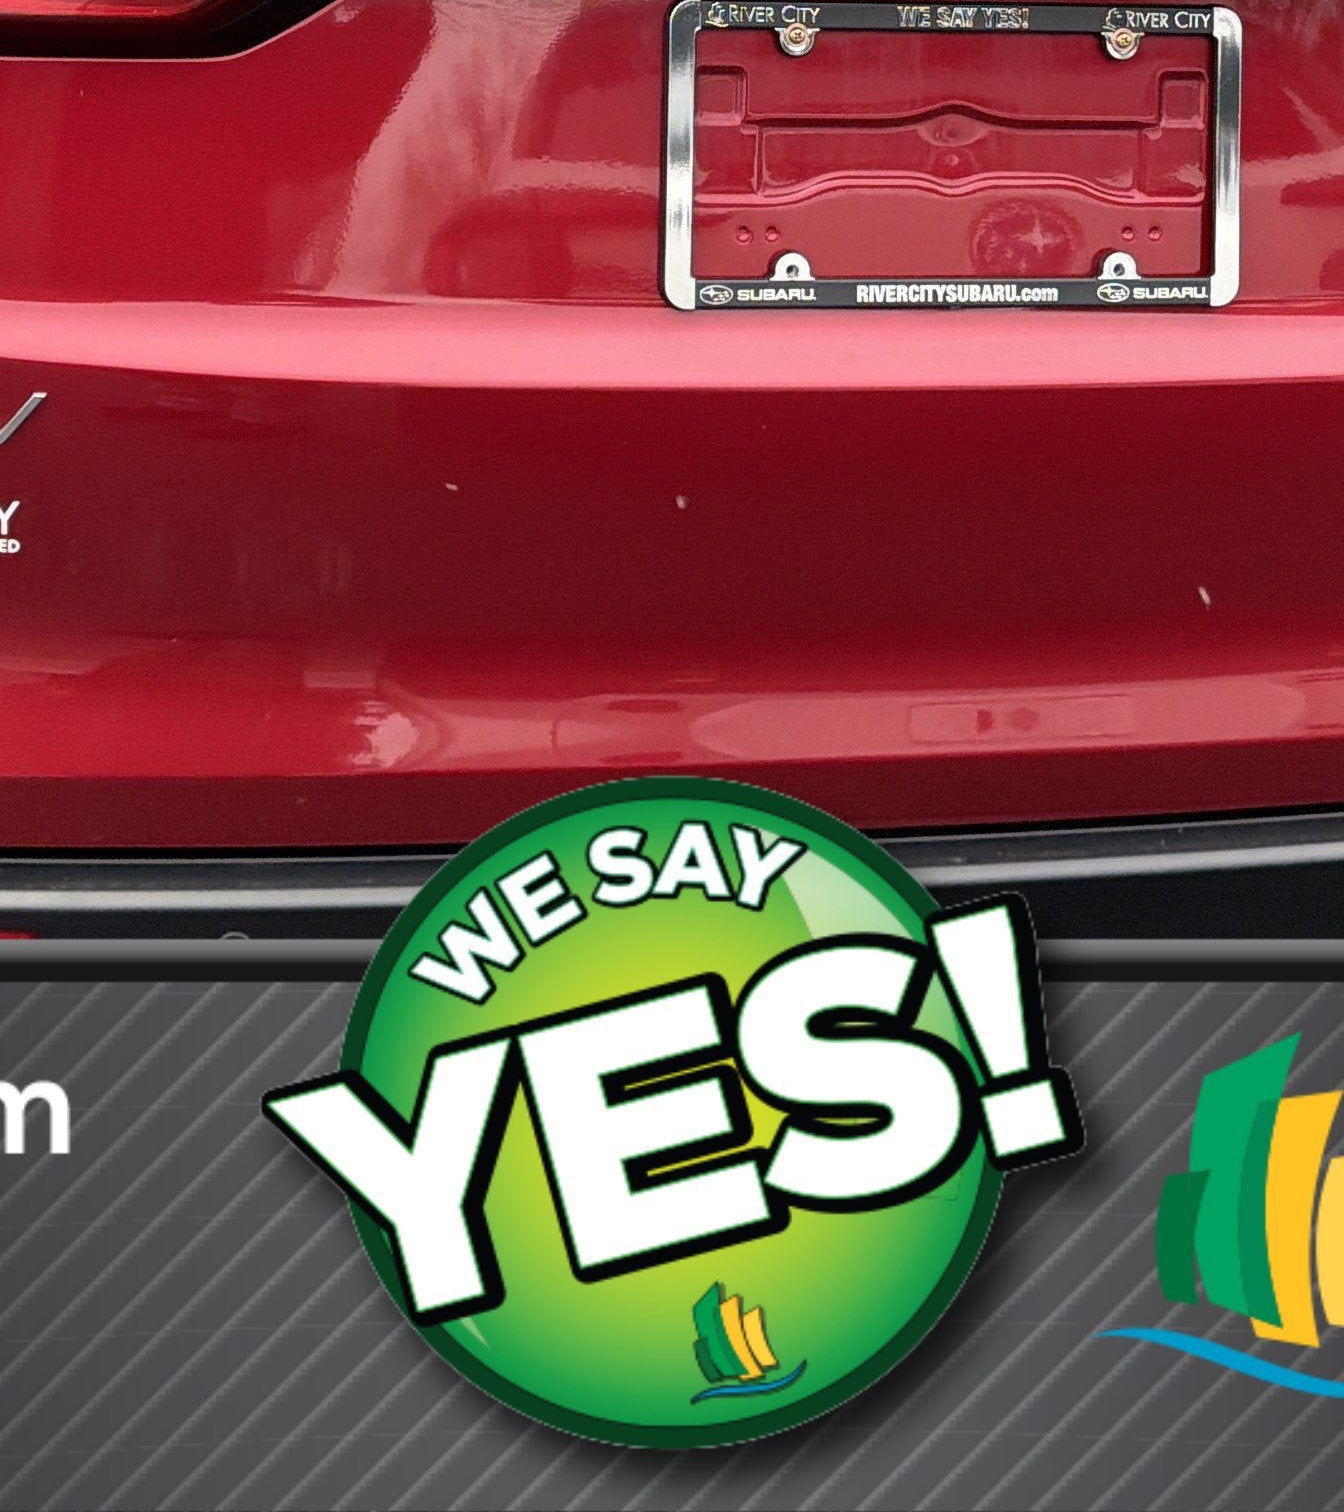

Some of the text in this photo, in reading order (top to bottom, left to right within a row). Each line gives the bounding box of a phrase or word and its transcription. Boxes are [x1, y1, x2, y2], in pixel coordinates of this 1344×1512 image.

[728, 4, 821, 24] RIVER CITY
[896, 5, 1030, 29] WE SAY YES!
[1125, 9, 1211, 29] RIVER CITY
[736, 289, 816, 302] SUBARU
[855, 284, 1059, 304] RIVERCITYSUBARU.com
[1132, 286, 1208, 300] SUBARU
